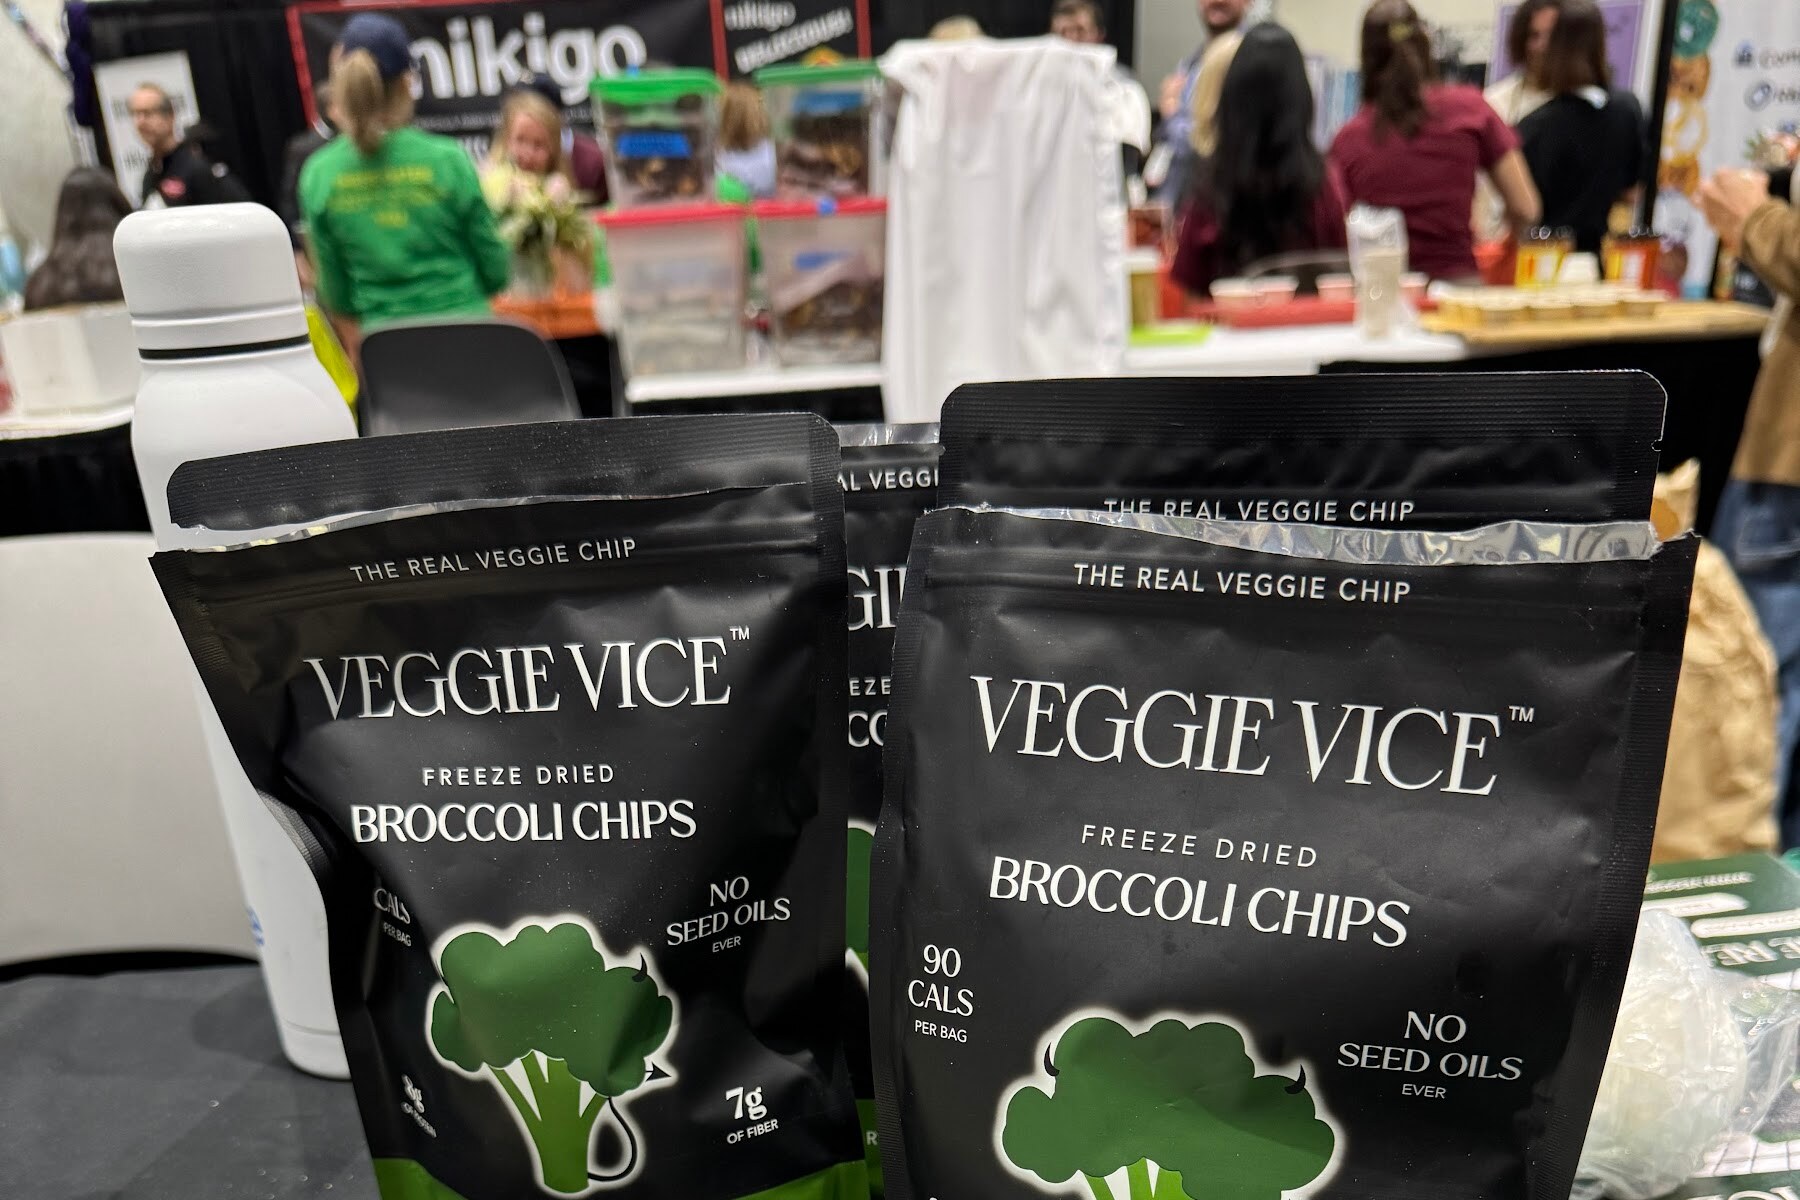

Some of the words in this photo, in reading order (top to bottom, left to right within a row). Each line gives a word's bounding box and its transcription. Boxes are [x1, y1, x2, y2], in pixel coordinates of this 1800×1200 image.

[1163, 501, 1227, 521] REAL
[1238, 501, 1338, 521] VEGGIE
[1349, 501, 1416, 522] CHIP
[350, 562, 399, 581] THE
[408, 555, 469, 575] REAL
[475, 545, 569, 568] VEGGIE
[579, 539, 635, 560] CHIP
[1074, 563, 1125, 587] THE
[1138, 567, 1204, 592] REAL
[1217, 572, 1325, 599] VEGGIE
[1339, 578, 1410, 603] CHIP
[304, 645, 560, 720] VEGGIE
[564, 636, 730, 711] VICE
[970, 676, 1274, 775] VEGGIE
[1293, 701, 1500, 795] VICE
[423, 767, 521, 786] FREEZE
[537, 765, 613, 784] DRIED
[351, 803, 562, 842] BROCCOLI
[573, 800, 696, 840] CHIPS
[1082, 825, 1196, 855] FREEZE
[1216, 839, 1316, 867] DRIED
[710, 876, 750, 906] NO
[989, 855, 1235, 926] BROCCOLI
[1248, 888, 1410, 946] CHIPS
[666, 912, 729, 946] SEED
[733, 898, 792, 924] OILS
[712, 936, 742, 953] EVER
[924, 945, 961, 977] 90
[908, 980, 974, 1017] CALS
[915, 1020, 936, 1036] PER
[941, 1026, 967, 1042] BAG
[1404, 1011, 1466, 1043] NO
[1338, 1043, 1429, 1072] SEED
[1440, 1053, 1522, 1080] OILS
[726, 1087, 769, 1120] 7g
[1402, 1084, 1446, 1099] EVER
[727, 1130, 743, 1144] OF
[745, 1119, 779, 1139] FIBER
